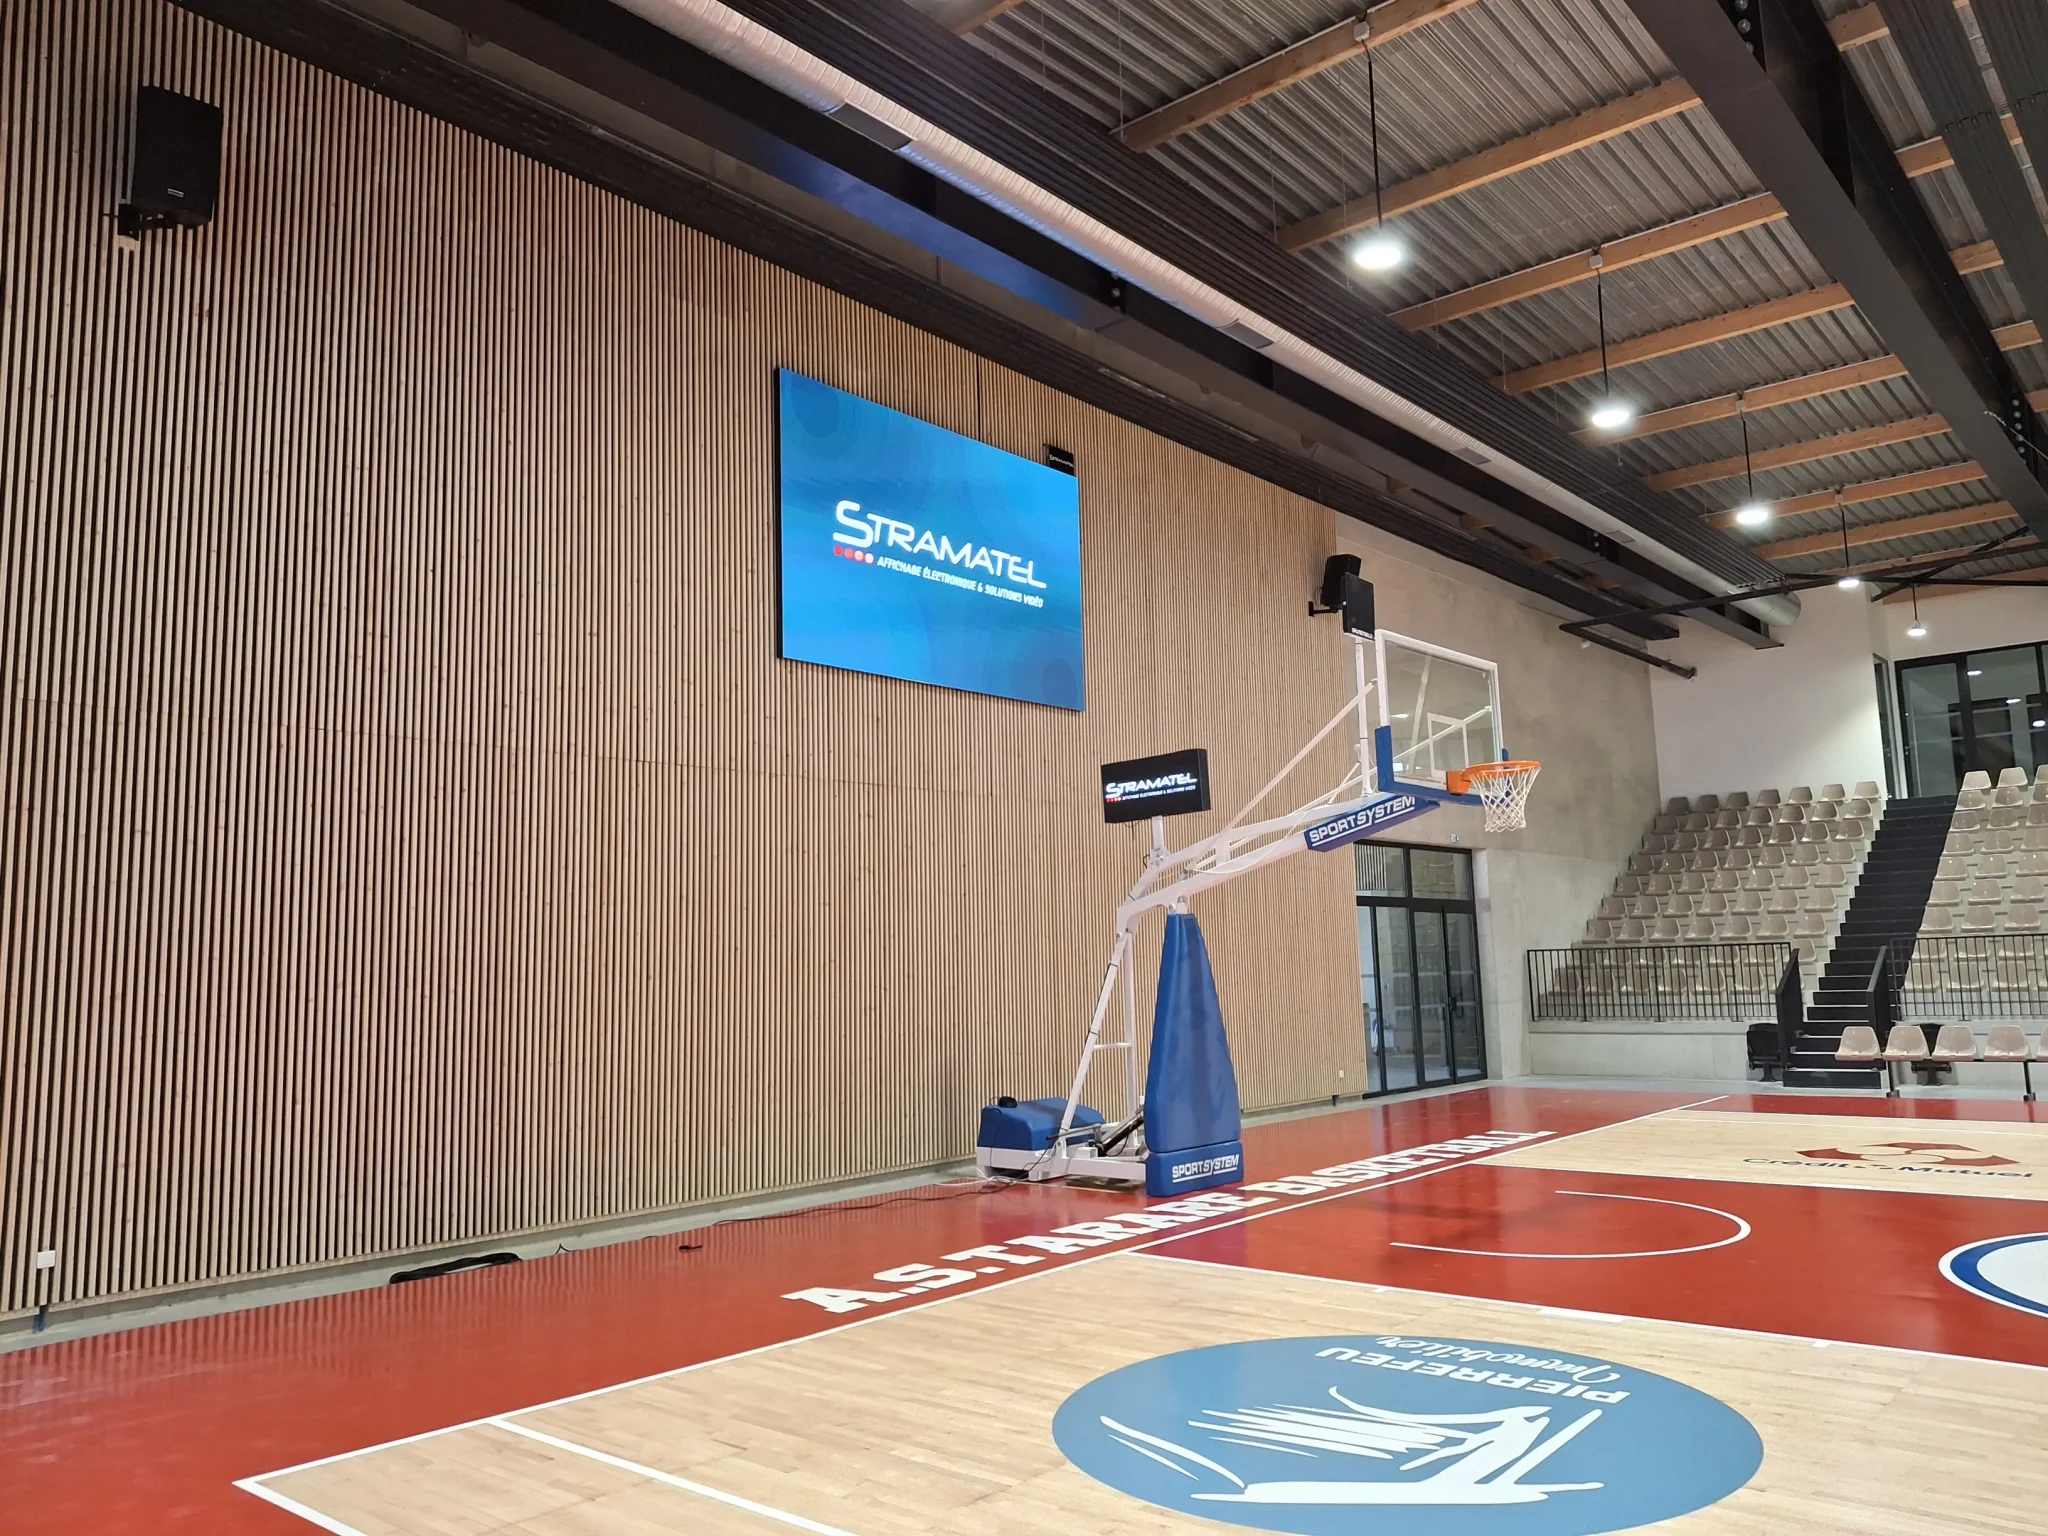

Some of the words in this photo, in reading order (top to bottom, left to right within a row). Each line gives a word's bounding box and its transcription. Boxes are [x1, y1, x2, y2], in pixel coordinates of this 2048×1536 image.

[832, 499, 1047, 589] STRAMATEL
[876, 555, 923, 577] AFFICHAGE
[984, 583, 1023, 603] SOLUTIONS
[1105, 772, 1198, 799] STRAMATEL
[1237, 1130, 1558, 1196] BASKETBALL
[1897, 1165, 2034, 1179] Mutuel
[1314, 1346, 1631, 1404] PIERREFEU
[1374, 1335, 1621, 1384] Immobilier
